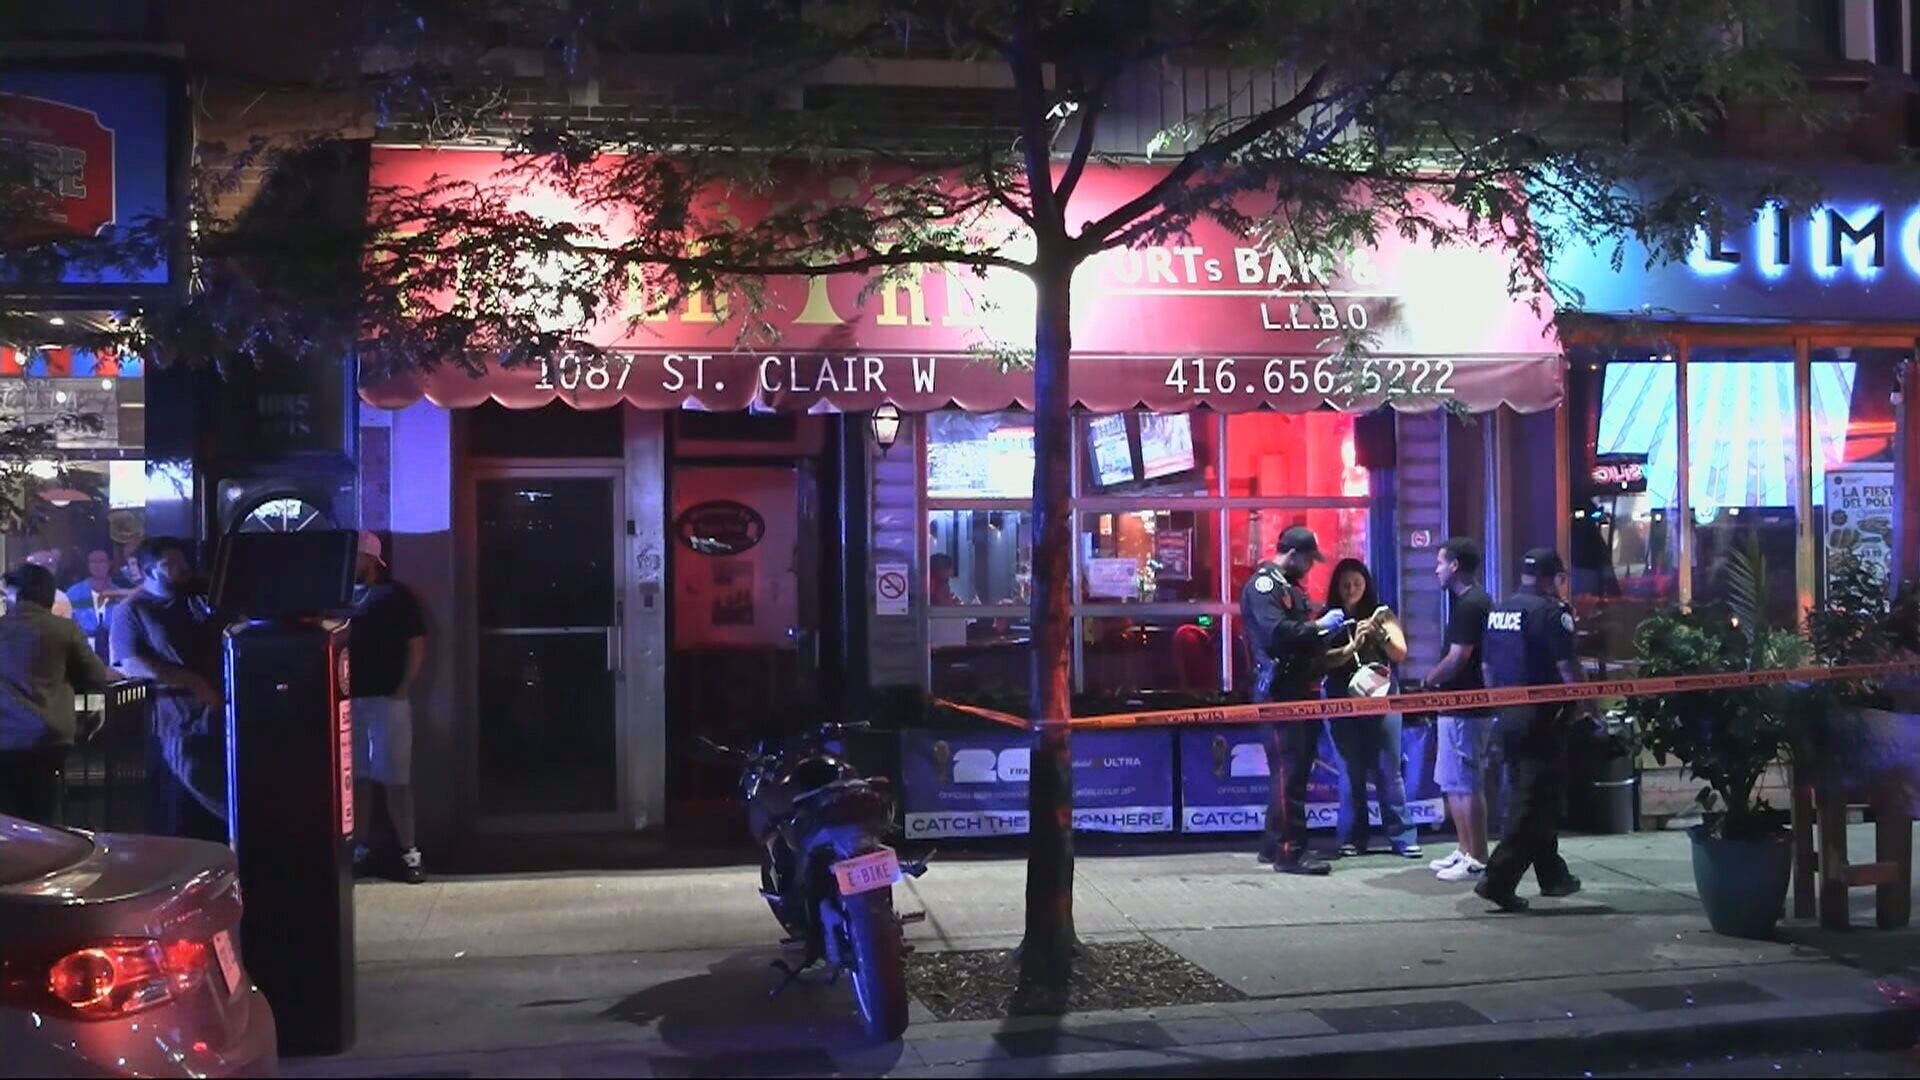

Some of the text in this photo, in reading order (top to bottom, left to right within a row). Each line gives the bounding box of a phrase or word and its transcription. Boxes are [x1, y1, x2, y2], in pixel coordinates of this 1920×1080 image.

[1708, 205, 1920, 268] LIM
[534, 353, 936, 394] 1087 ST. CLAIR W
[1841, 485, 1895, 498] LA FIEST
[1843, 498, 1861, 509] DEL
[1487, 610, 1522, 631] POLICE
[1424, 695, 1457, 707] BACK
[1459, 693, 1489, 705] STAY
[1291, 704, 1322, 716] BACK
[1322, 702, 1352, 714] STAY
[1103, 757, 1141, 768] ULTRA
[912, 817, 981, 832] CATCH
[984, 815, 1026, 828] THE
[1113, 811, 1164, 827] HERE
[1191, 811, 1259, 825] CATCH
[847, 863, 891, 887] E-BIKE
